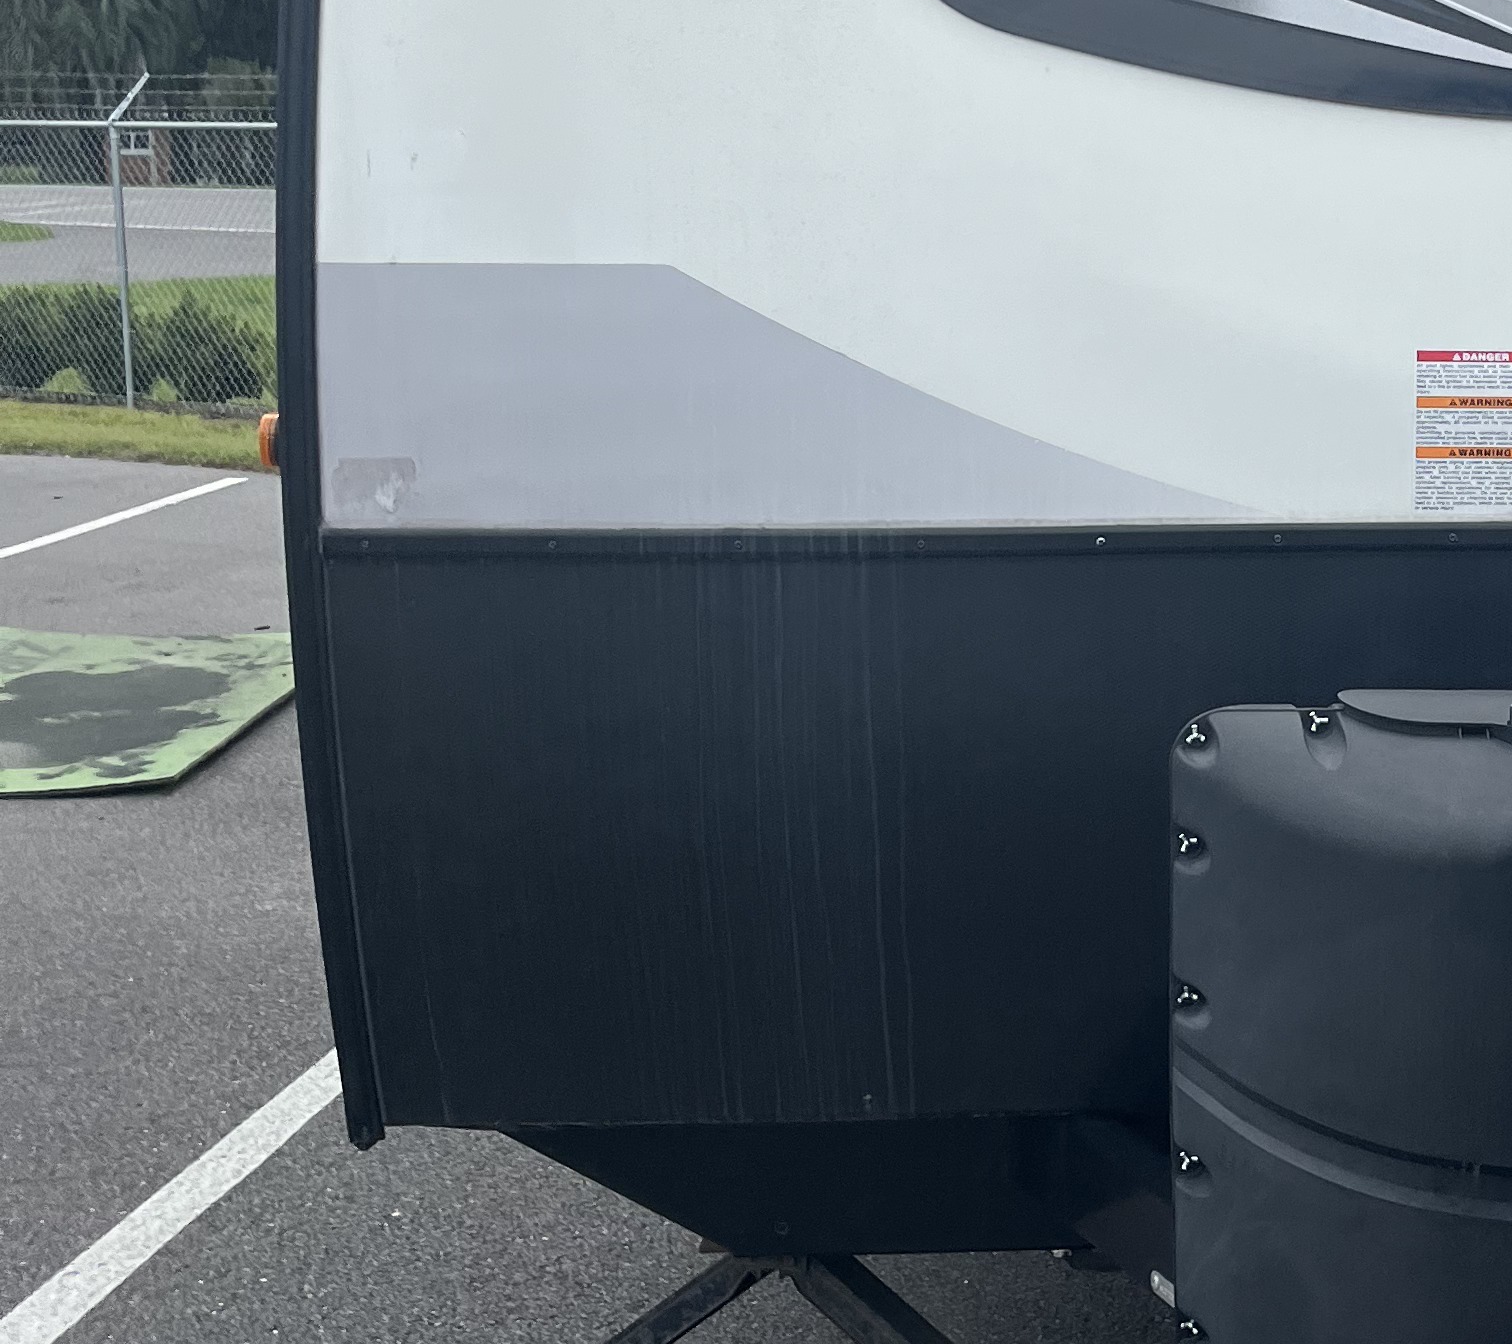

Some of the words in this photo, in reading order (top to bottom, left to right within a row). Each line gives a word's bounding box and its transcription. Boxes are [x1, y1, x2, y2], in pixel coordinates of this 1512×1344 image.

[1462, 352, 1510, 362] DANGER
[1458, 398, 1512, 407] WARNING
[1457, 448, 1512, 457] WARNING
